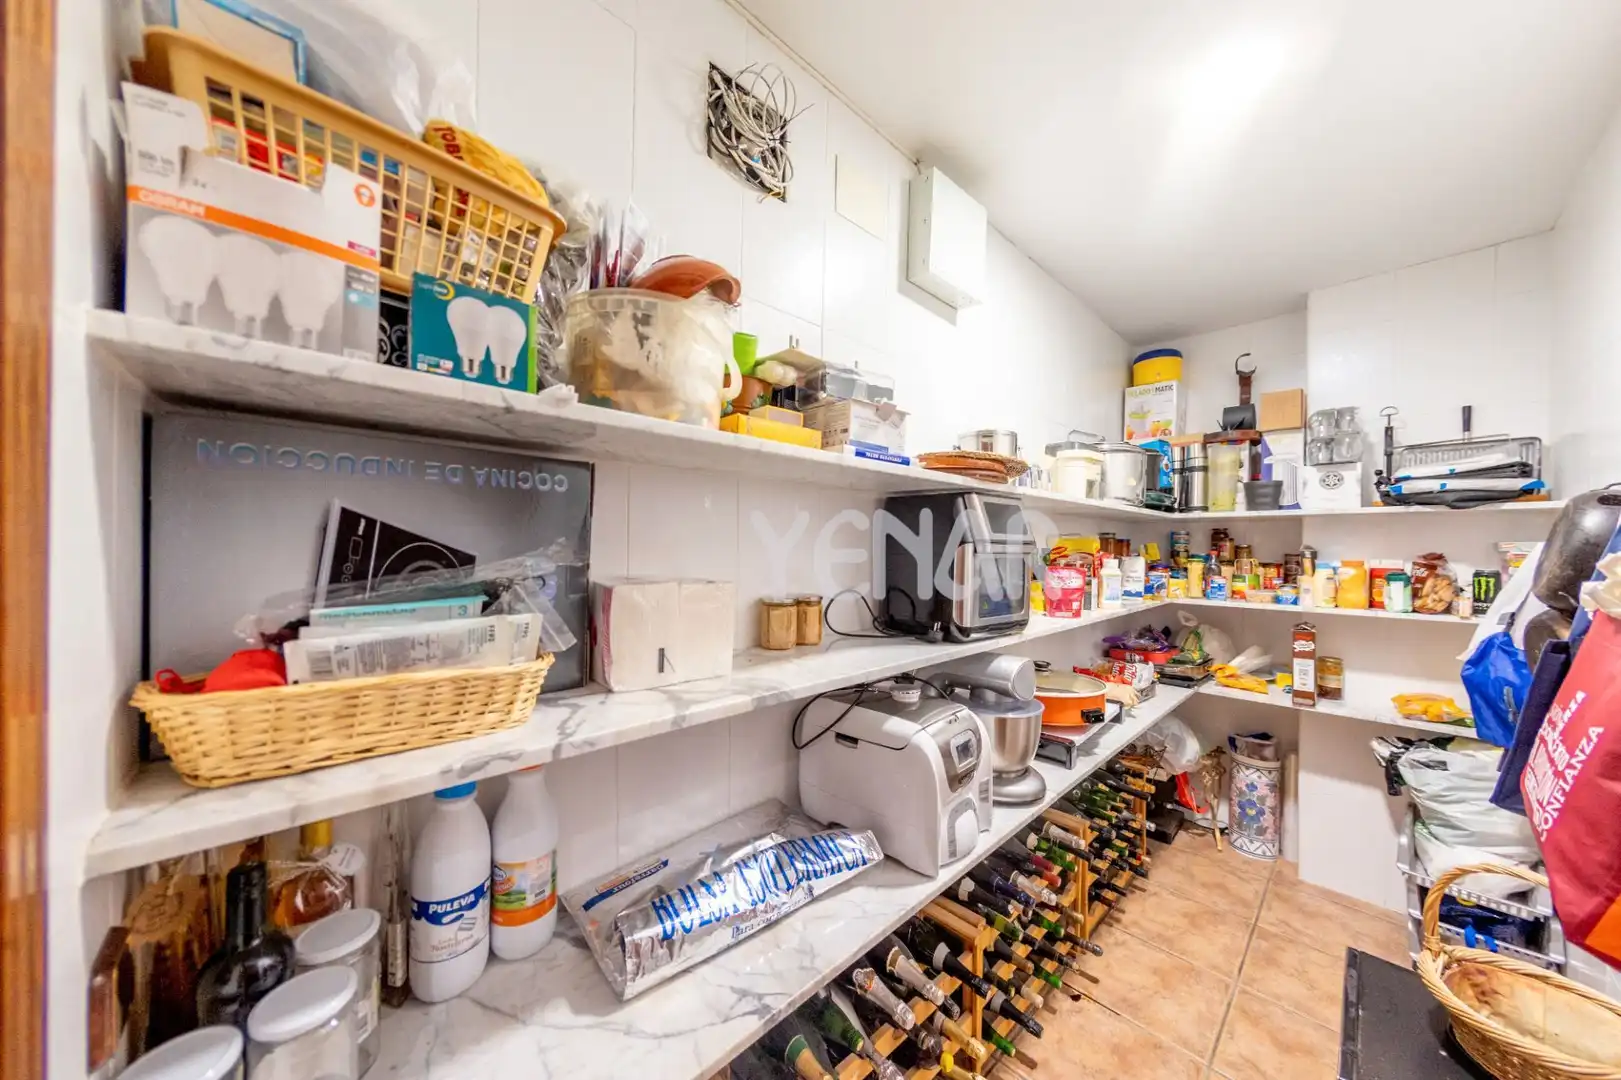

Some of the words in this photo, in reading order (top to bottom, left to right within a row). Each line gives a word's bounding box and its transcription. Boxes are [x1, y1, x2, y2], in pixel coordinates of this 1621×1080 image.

[1154, 384, 1175, 394] MATIC
[196, 438, 416, 477] INDUCCION
[424, 460, 464, 485] DE
[470, 465, 569, 493] COCINA
[428, 894, 476, 914] PULEVA
